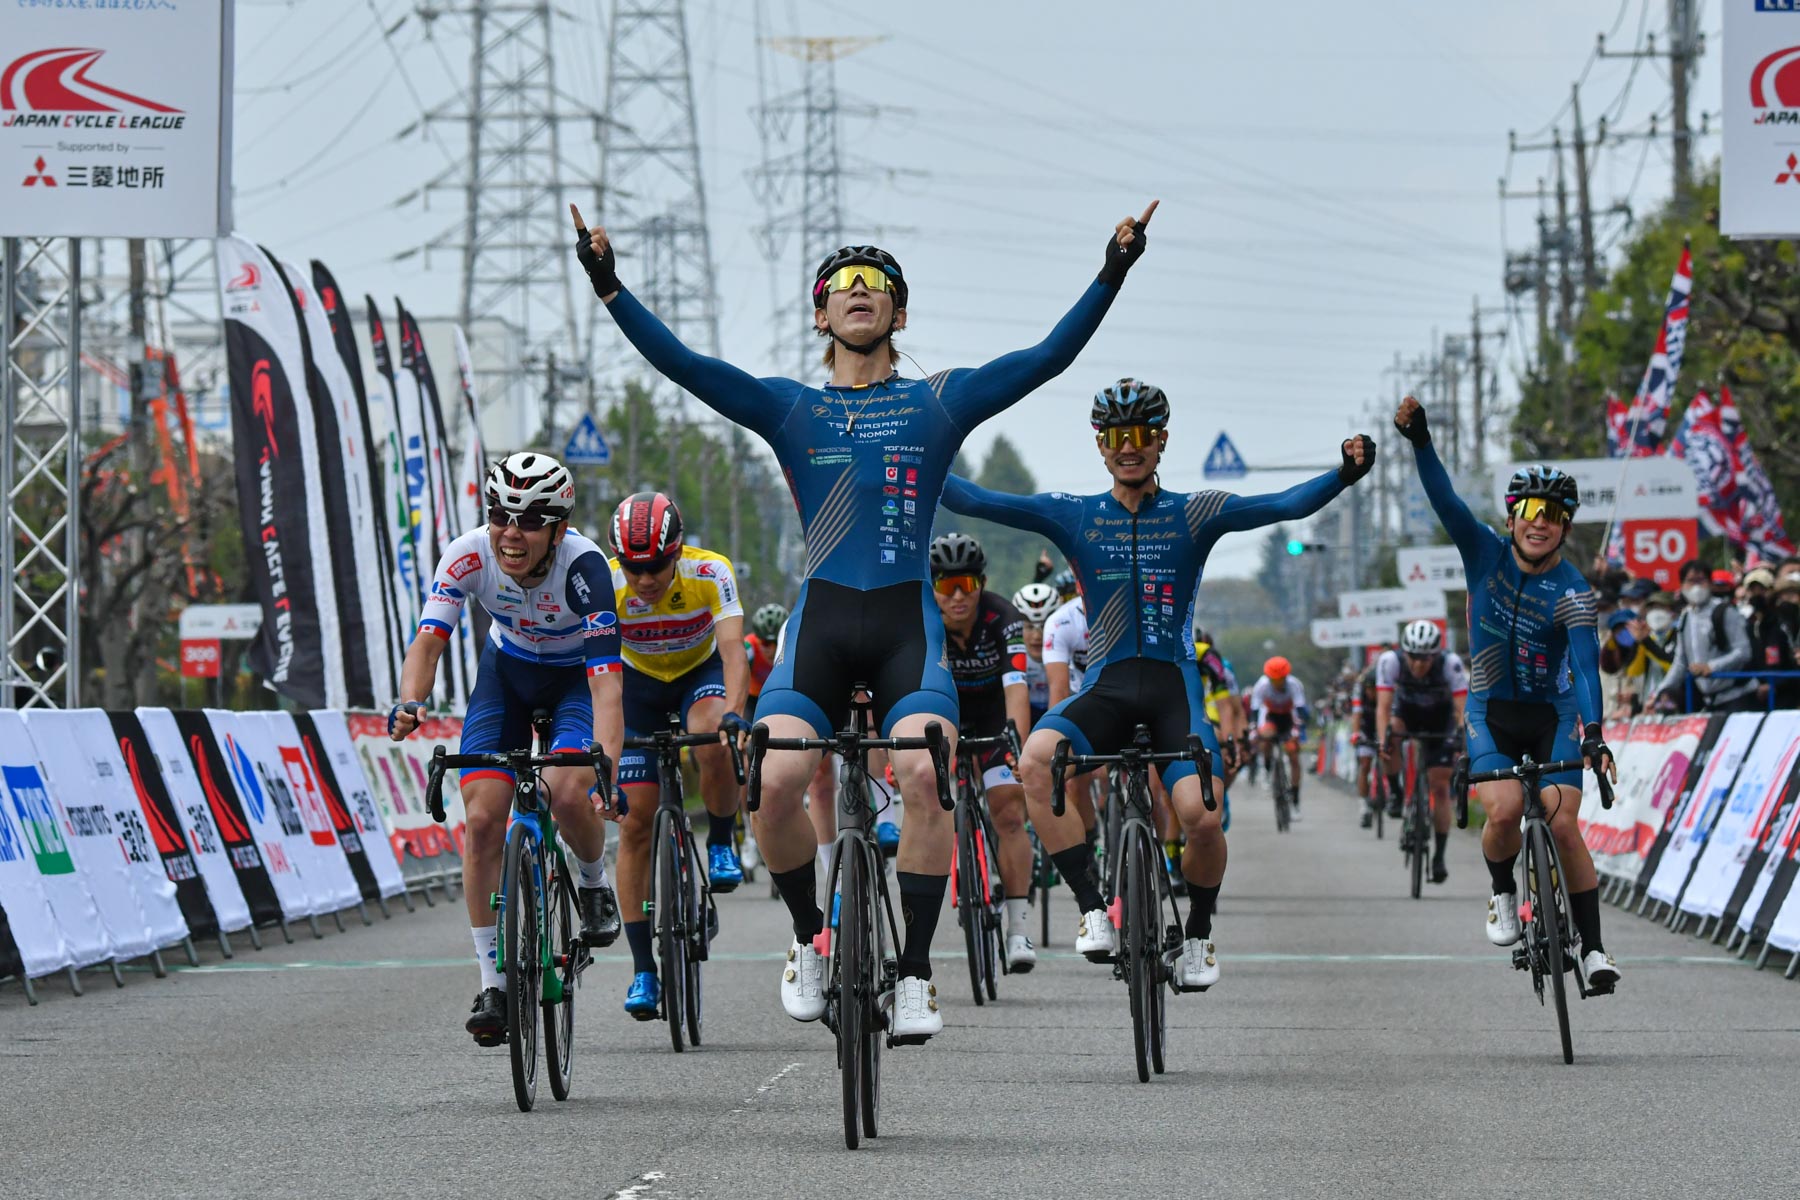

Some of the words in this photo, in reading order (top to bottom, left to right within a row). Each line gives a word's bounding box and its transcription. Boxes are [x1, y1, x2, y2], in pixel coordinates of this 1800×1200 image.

[3, 114, 61, 127] JAPAN
[63, 115, 116, 128] CYCLE
[119, 116, 185, 129] LEAGUE
[1754, 111, 1800, 125] JAPA
[57, 141, 114, 152] Supported
[117, 143, 130, 152] by
[67, 166, 164, 188] 三菱地所
[859, 430, 897, 439] NOMON
[1099, 544, 1171, 552] TSUNGARU
[1633, 529, 1686, 563] 50
[617, 769, 647, 779] VOLT
